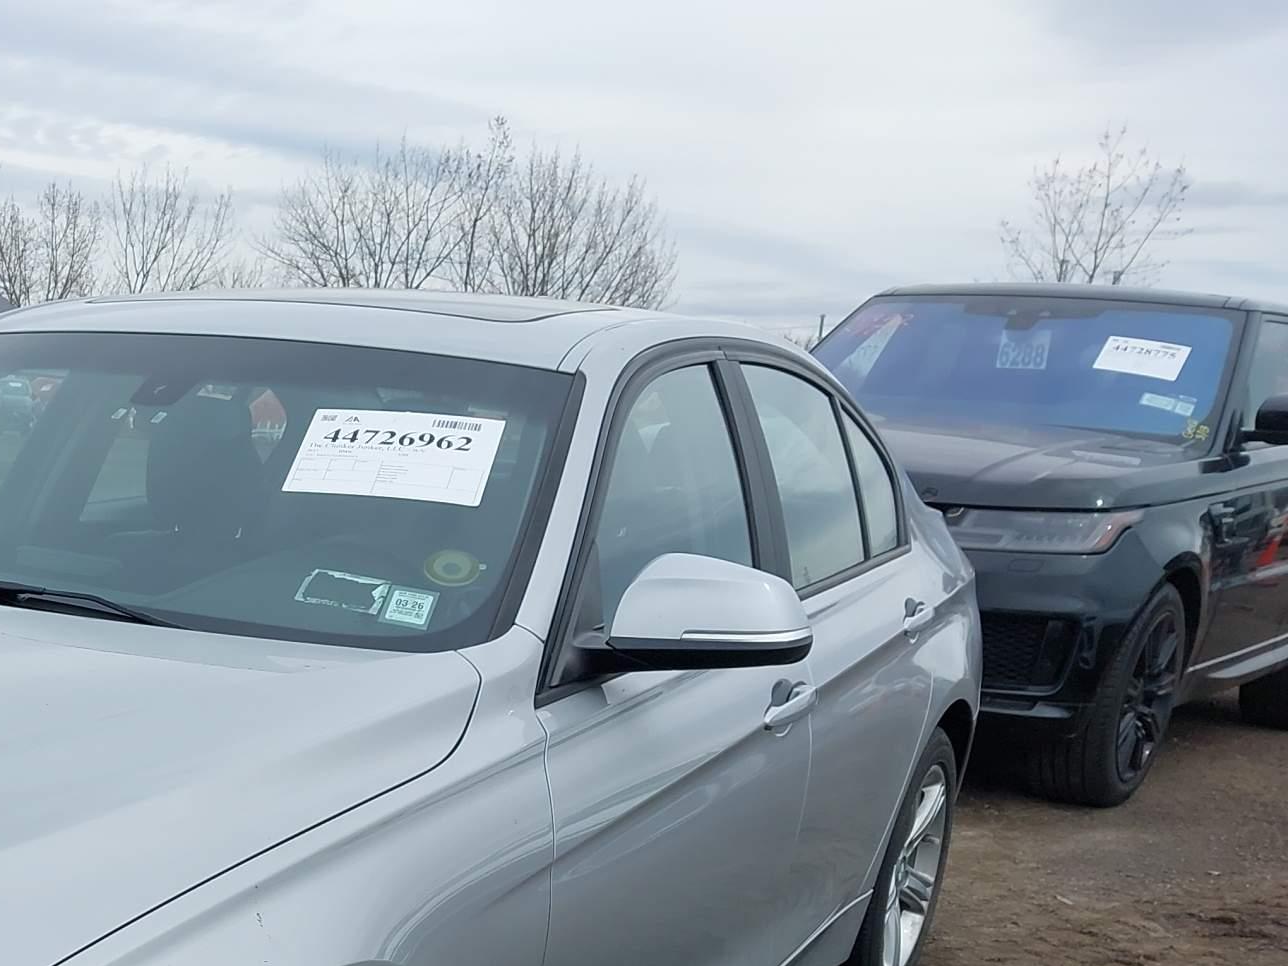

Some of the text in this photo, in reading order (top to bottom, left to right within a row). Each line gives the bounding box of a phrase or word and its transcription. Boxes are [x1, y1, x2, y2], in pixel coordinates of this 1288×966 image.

[323, 428, 473, 452] 44726962
[395, 598, 425, 610] 03 26
